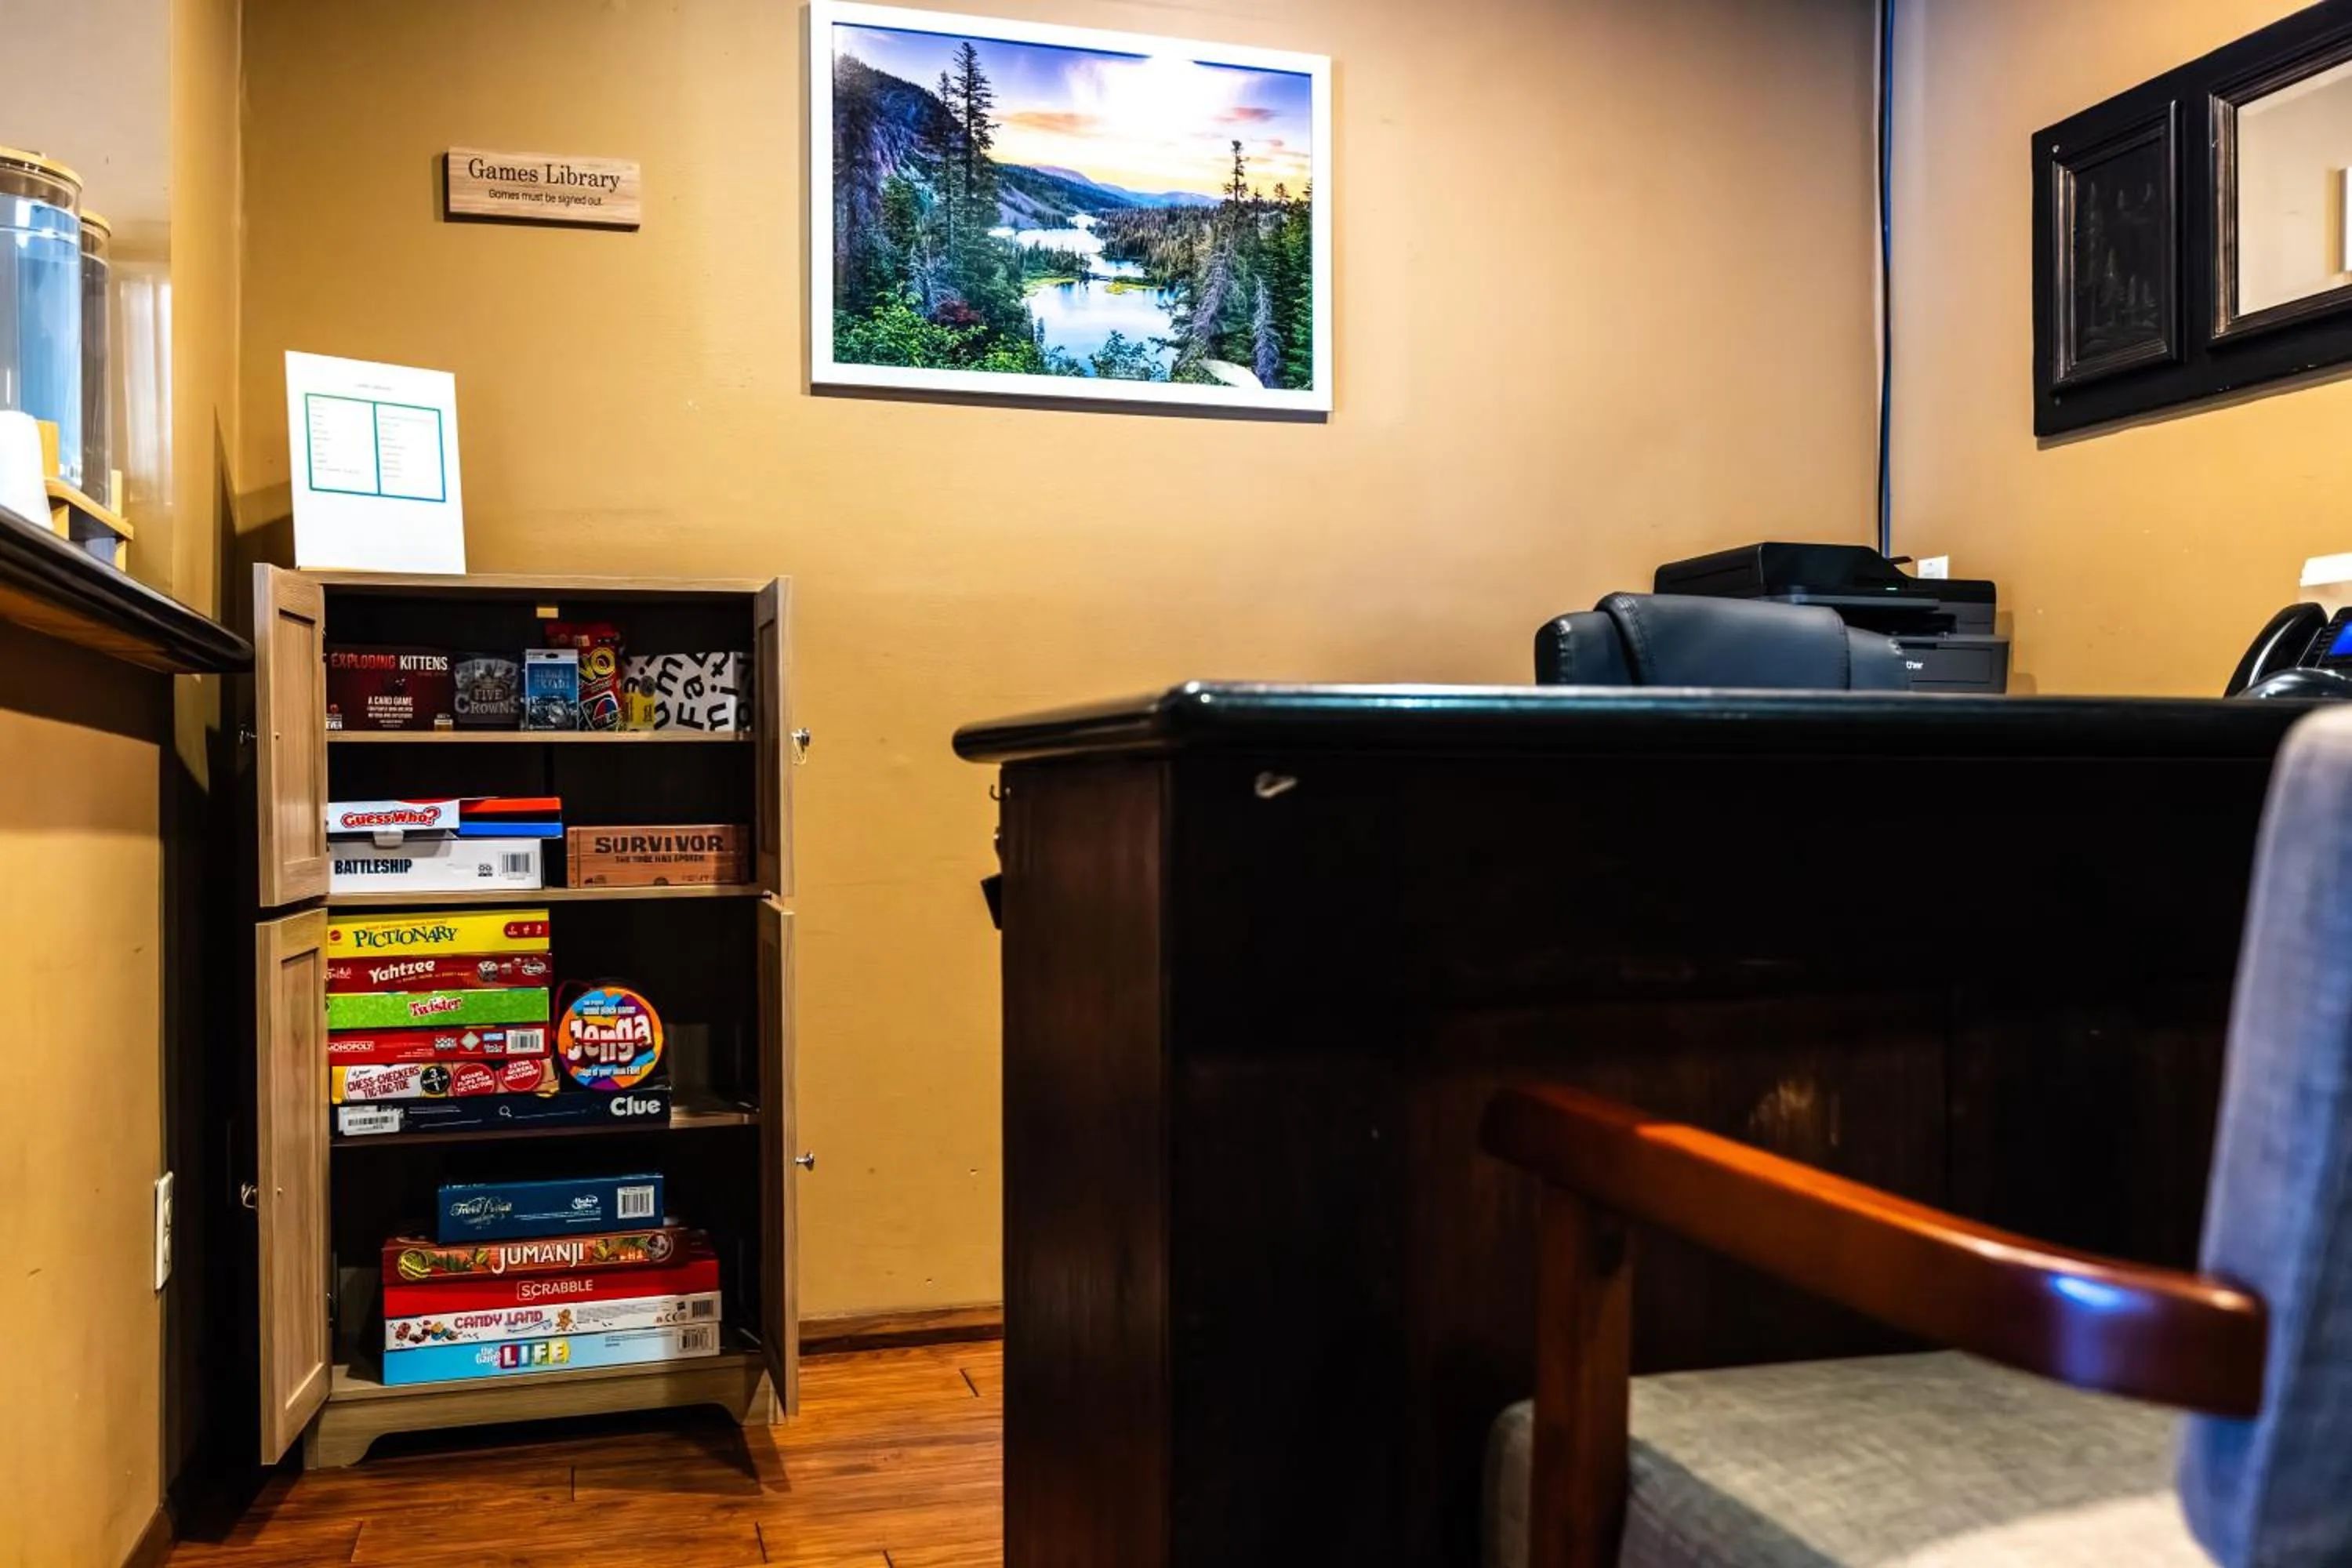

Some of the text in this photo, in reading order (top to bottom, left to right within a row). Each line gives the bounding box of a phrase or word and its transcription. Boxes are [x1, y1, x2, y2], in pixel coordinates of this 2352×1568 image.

[468, 158, 620, 193] Games Library
[488, 189, 520, 201] Games
[521, 191, 543, 201] must
[545, 191, 556, 203] be
[558, 194, 586, 207] signed
[330, 652, 448, 671] EXPLODING KITTENS
[474, 689, 503, 701] FIVE
[595, 834, 724, 854] SURVIVOR
[334, 858, 412, 875] BATTLESHIP
[353, 924, 458, 948] PICTIONARY
[368, 960, 436, 984] Yahtzee
[409, 997, 463, 1017] Twister
[568, 1014, 653, 1064] Jenga
[610, 1095, 661, 1116] Clue
[492, 1242, 584, 1274] JUMANJI
[519, 1279, 593, 1298] SCRABBLE
[454, 1309, 543, 1329] CANDY LAND
[503, 1341, 567, 1367] LIFE
